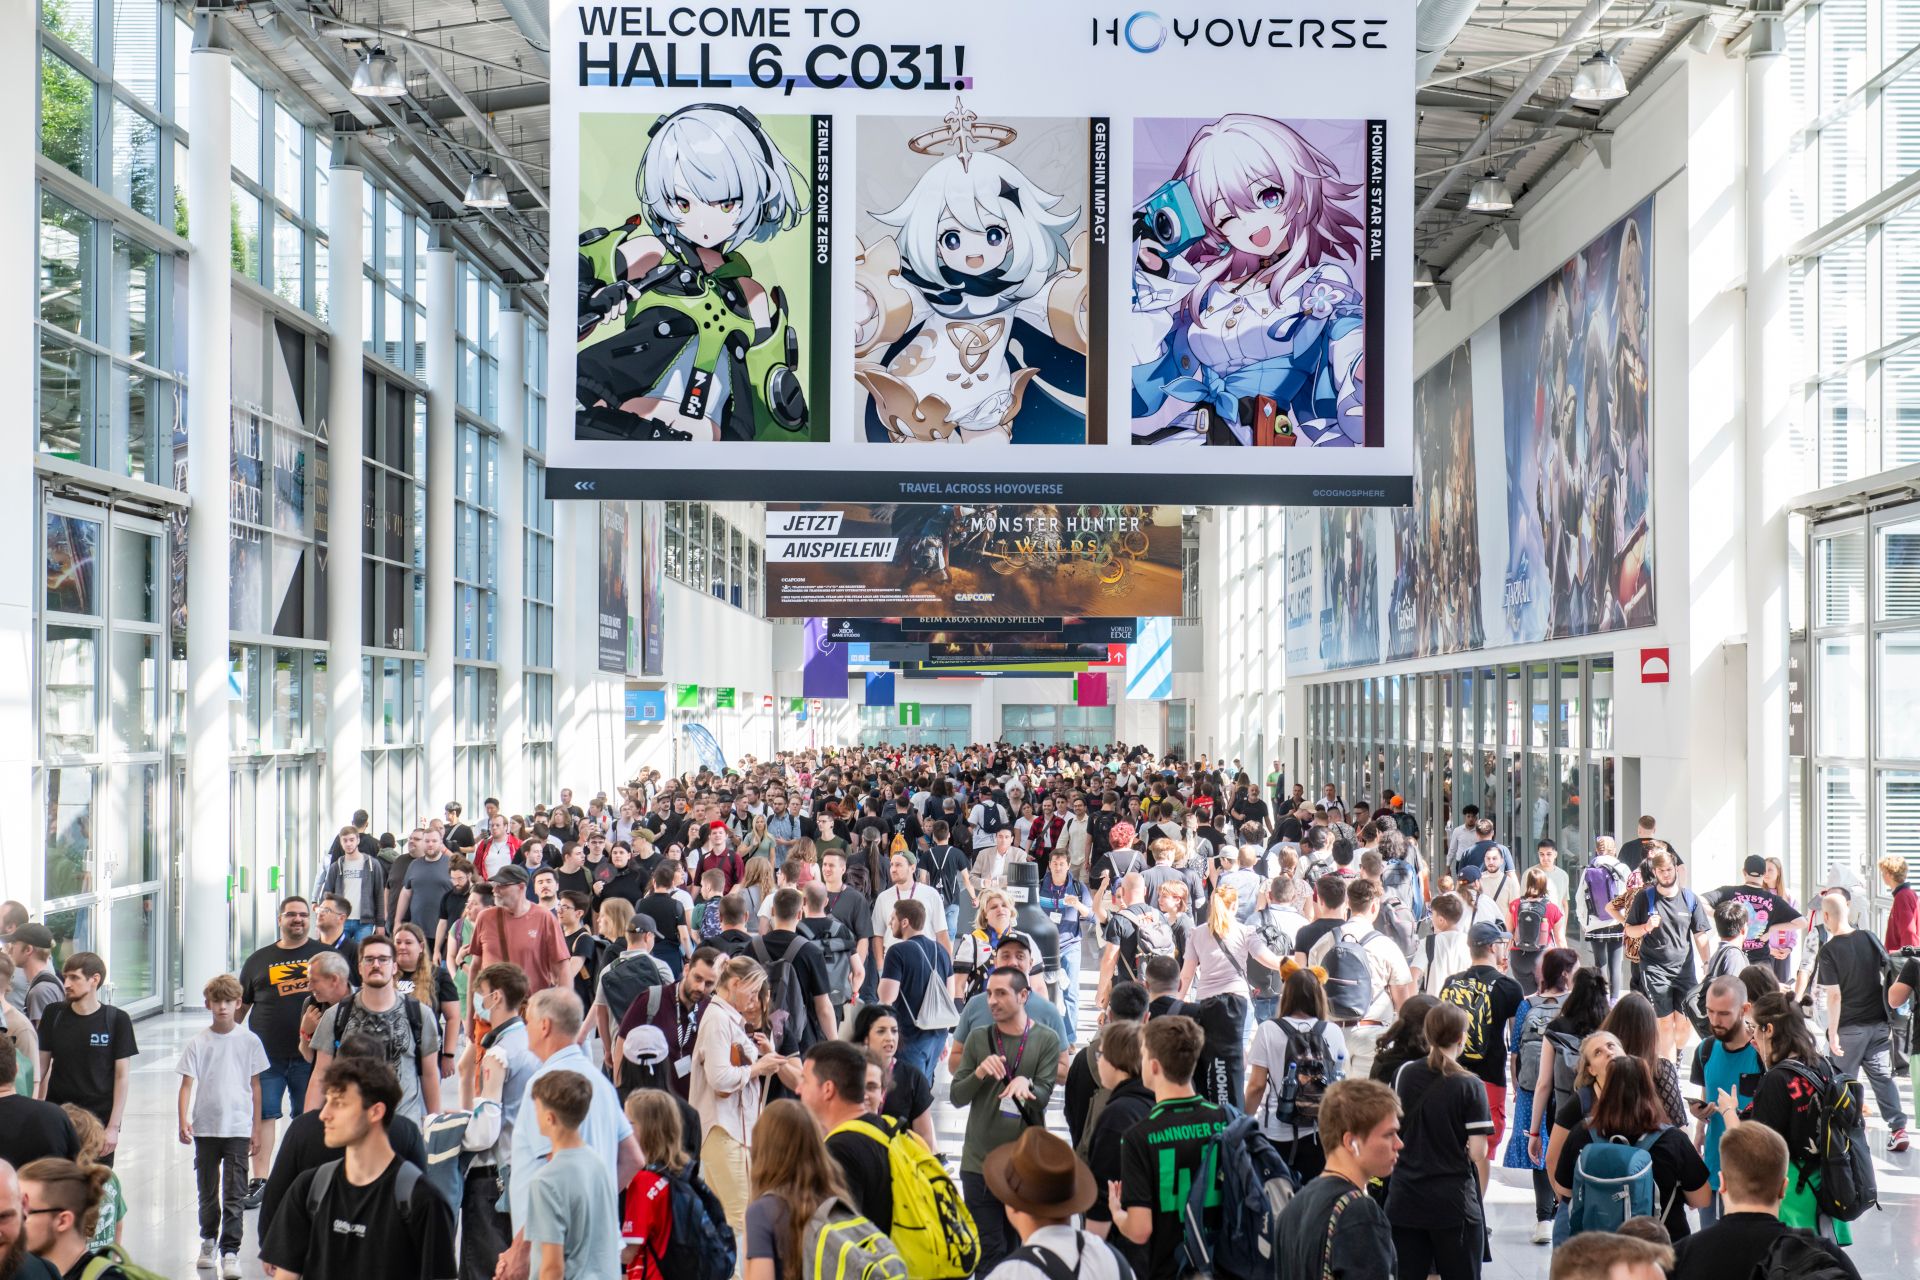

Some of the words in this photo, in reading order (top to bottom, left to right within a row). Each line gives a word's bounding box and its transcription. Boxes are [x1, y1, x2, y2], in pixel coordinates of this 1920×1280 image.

[578, 6, 790, 38] WELCOME
[805, 8, 860, 38] TO
[1093, 10, 1388, 54] HOYOVERSE
[578, 42, 732, 88] HALL
[817, 120, 828, 181] ZENLESS
[1095, 122, 1106, 185] GENSHIN
[1371, 124, 1382, 185] HONKAI:
[817, 185, 828, 223] ZONE
[1094, 188, 1106, 244] IMPACT
[1371, 189, 1382, 223] STAR
[817, 227, 828, 264] ZERO
[1370, 227, 1381, 261] RAIL
[899, 483, 943, 493] TRAVEL
[945, 483, 991, 494] ACROSS
[994, 484, 1063, 494] HOYOVERSE
[1312, 489, 1385, 498] ©COGNOSPHERE
[783, 515, 838, 531] JETZT
[969, 516, 1059, 533] MONSTER
[1066, 516, 1140, 533] HUNTER
[782, 542, 891, 558] ANSPIELEN!
[1014, 536, 1097, 557] WILDS
[955, 592, 995, 602] CAPCOM
[1007, 616, 1045, 624] SPIELEN
[1147, 1122, 1212, 1144] HANNOVER
